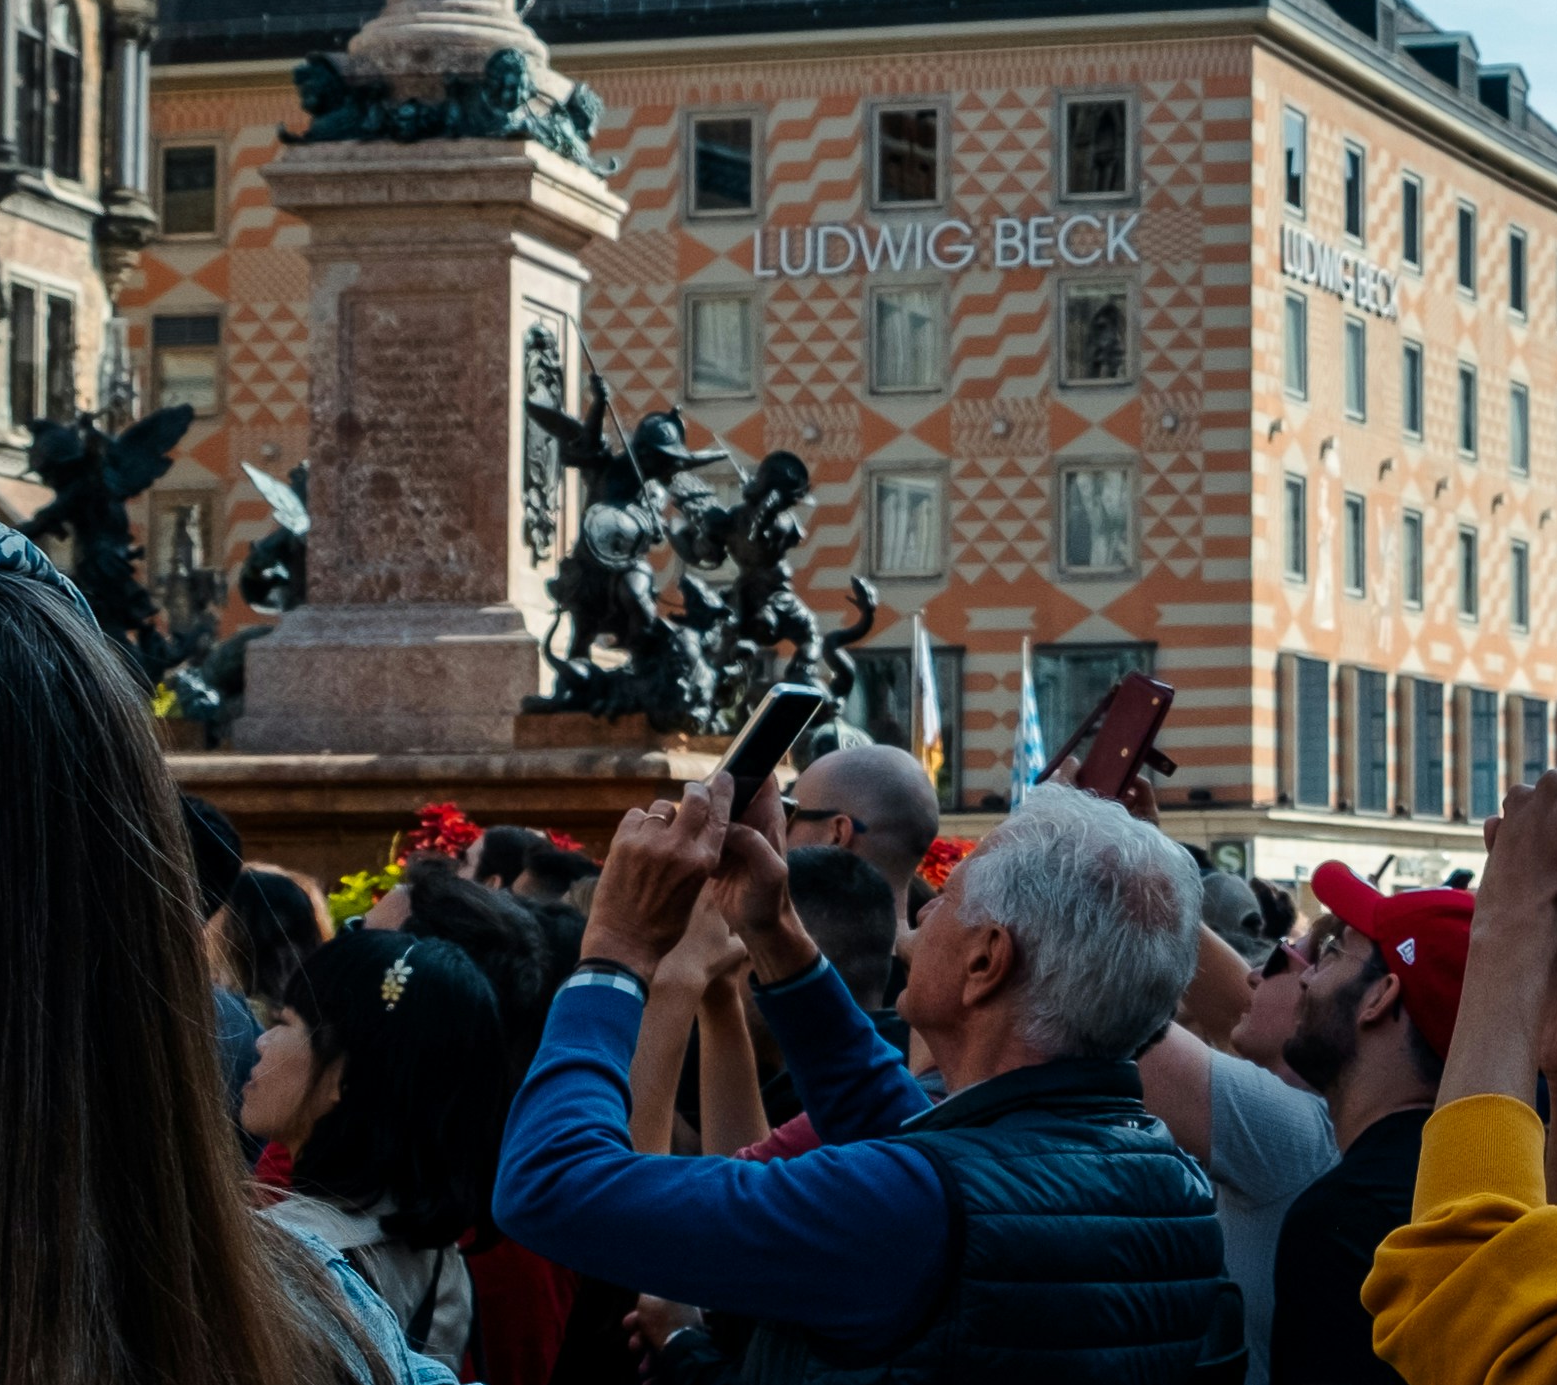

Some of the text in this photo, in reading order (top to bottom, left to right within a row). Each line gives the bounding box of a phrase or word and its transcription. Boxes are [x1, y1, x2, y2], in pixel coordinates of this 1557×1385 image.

[753, 213, 1141, 278] LUDWIG BECK
[1281, 221, 1400, 320] LUDWIG BECK
